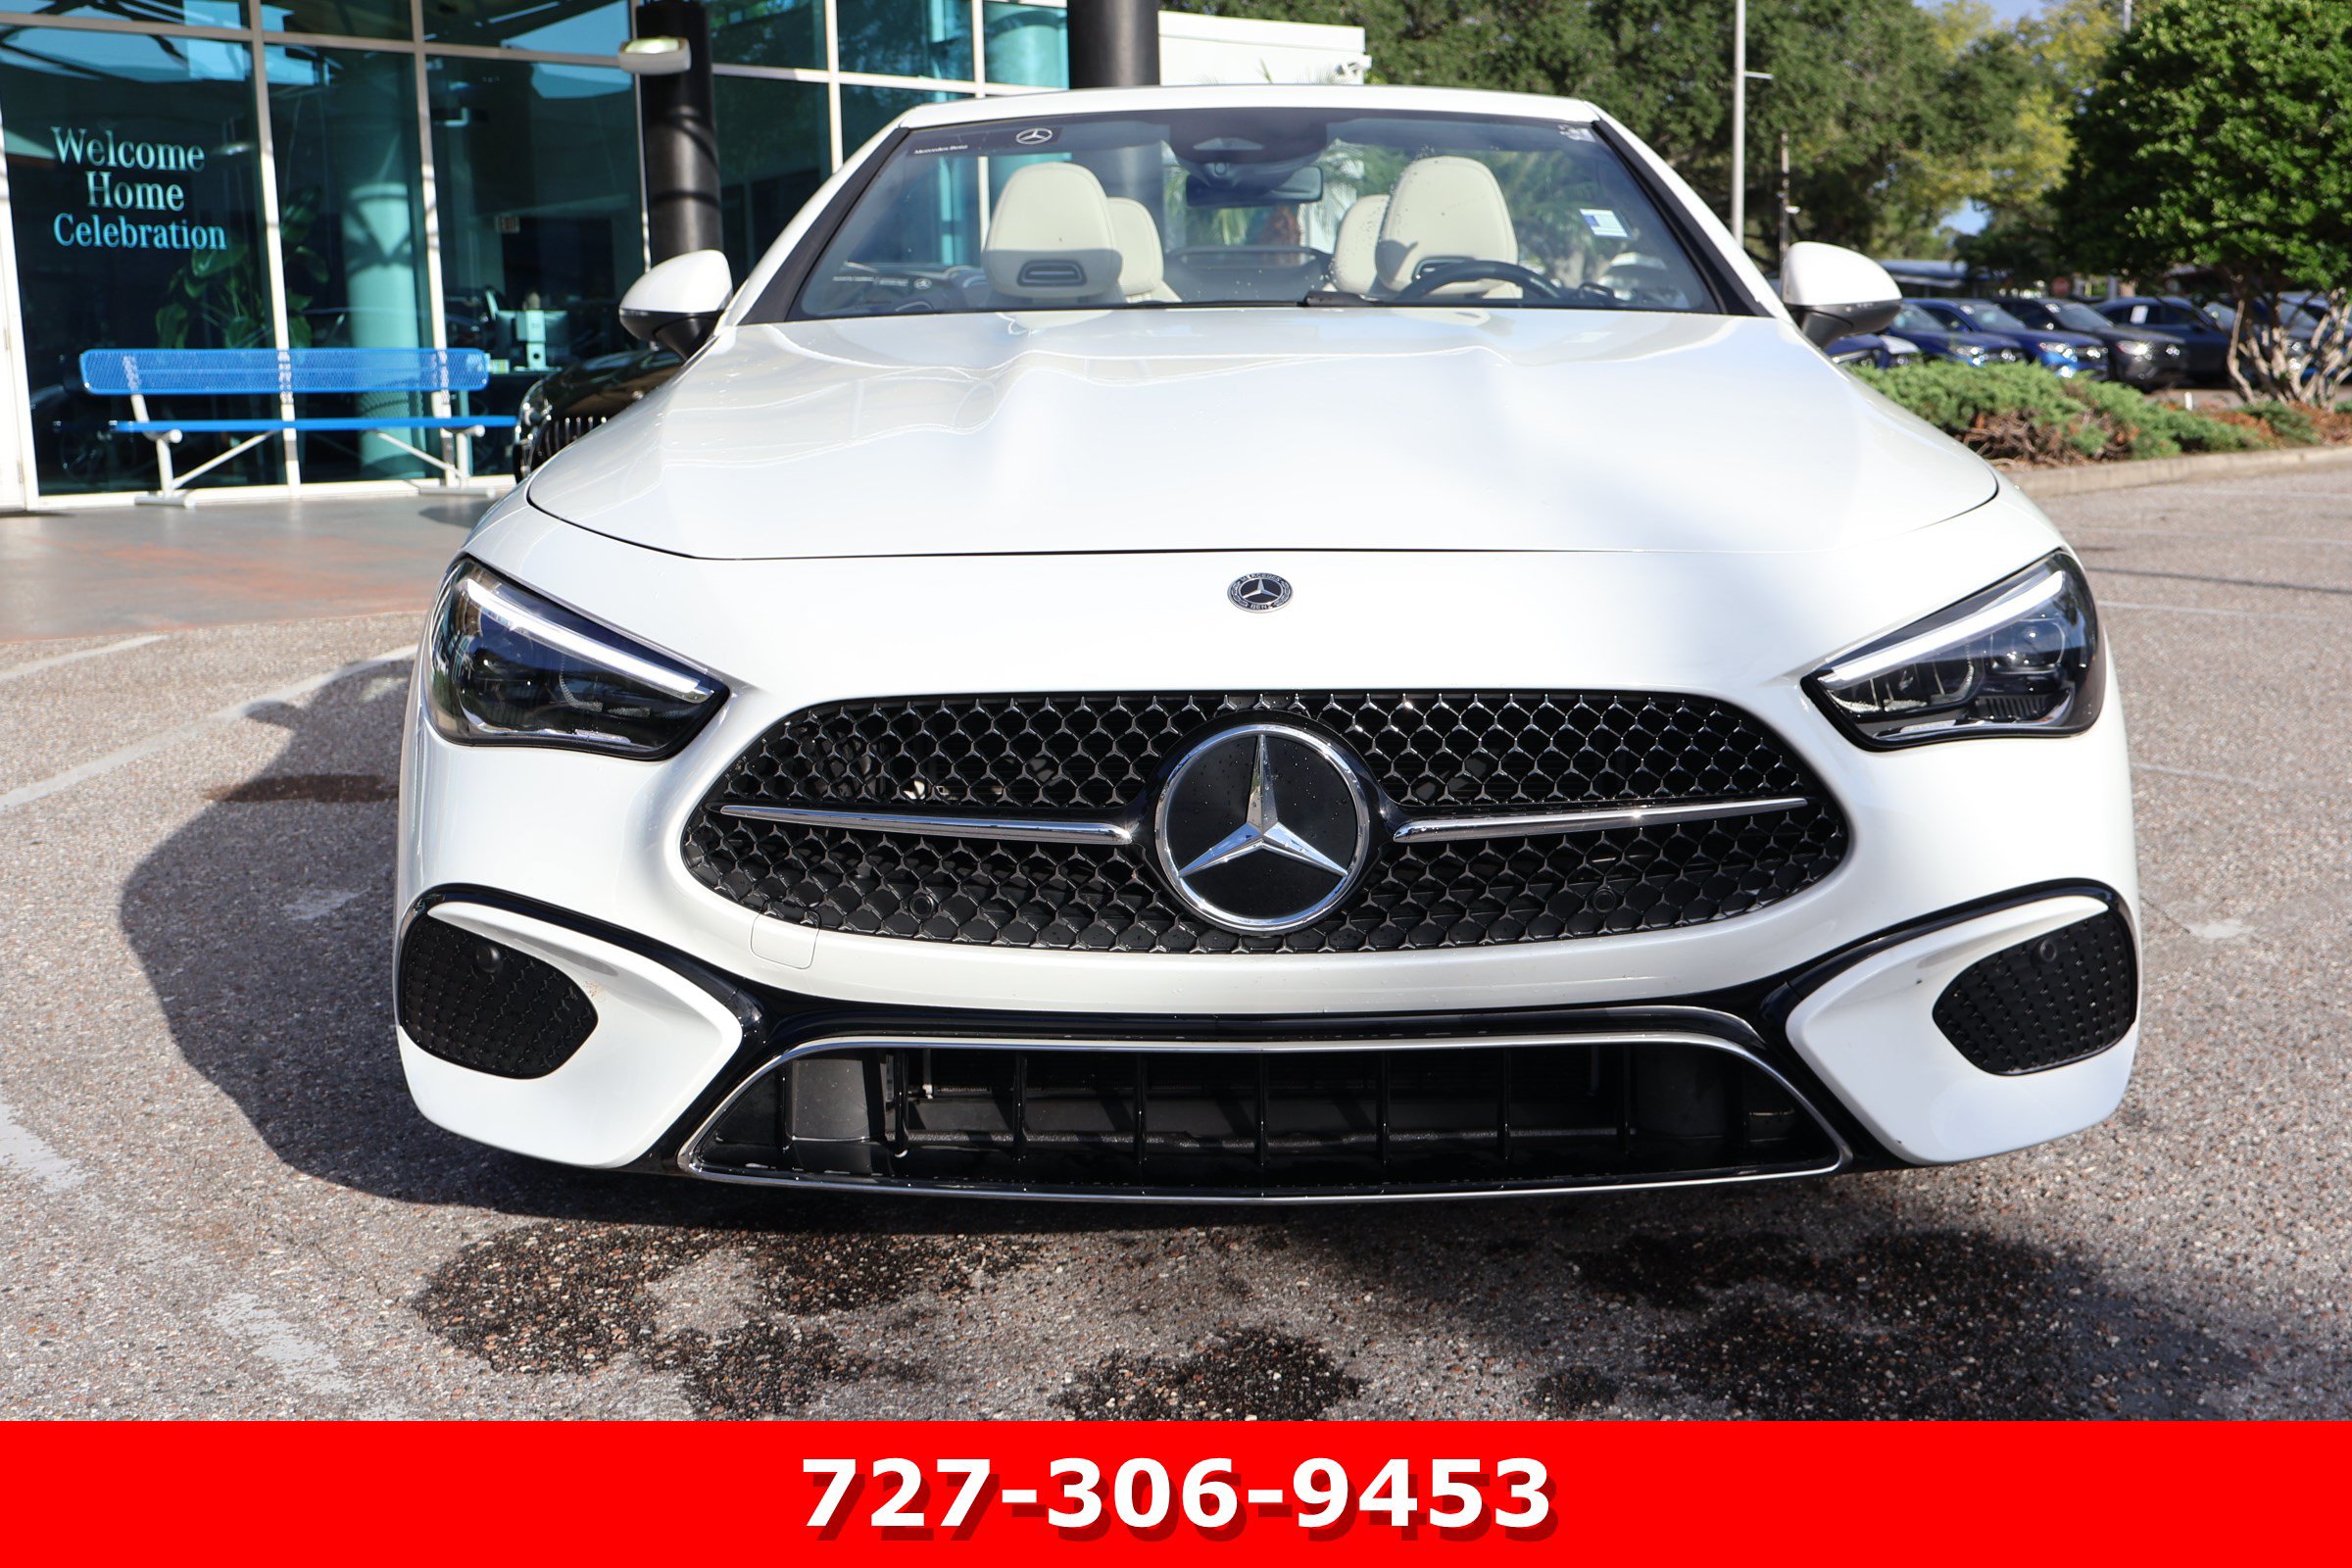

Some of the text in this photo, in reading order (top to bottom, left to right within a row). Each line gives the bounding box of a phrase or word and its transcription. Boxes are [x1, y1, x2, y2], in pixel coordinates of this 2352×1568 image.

[51, 126, 205, 172] Welcome
[85, 171, 184, 212] Home
[53, 213, 226, 250] Celebration
